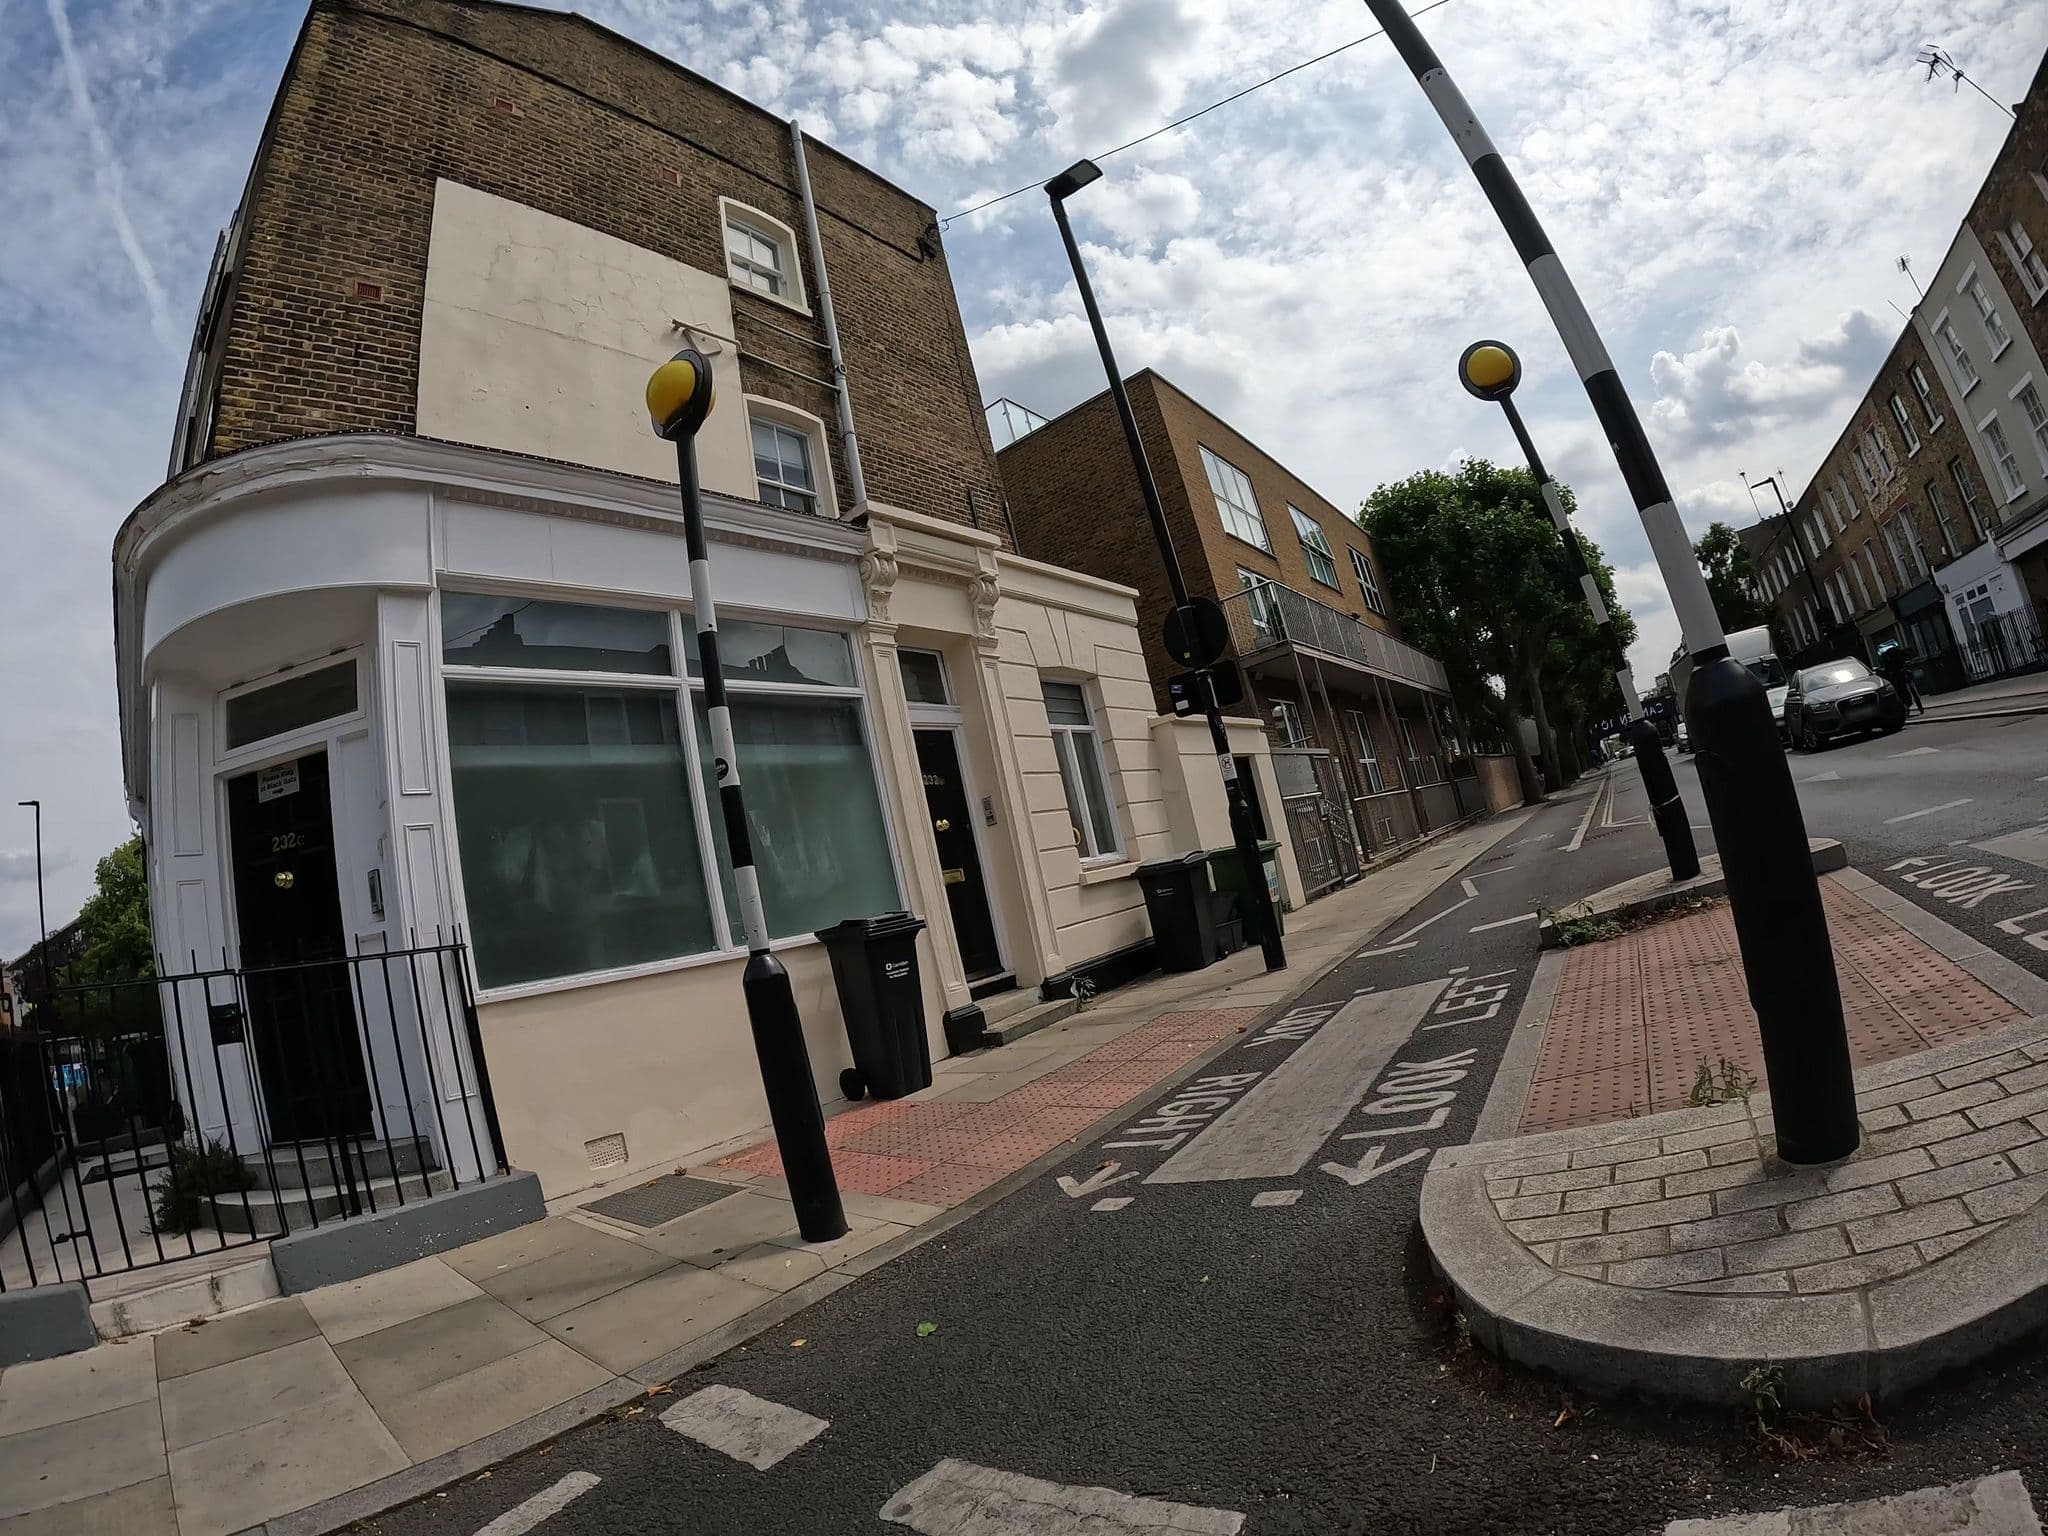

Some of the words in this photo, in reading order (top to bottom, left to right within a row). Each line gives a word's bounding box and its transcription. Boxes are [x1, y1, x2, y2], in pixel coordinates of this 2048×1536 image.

[1900, 859, 2038, 909] LOOK
[1243, 1000, 1346, 1049] LOOK
[1340, 1048, 1479, 1141] LOOK
[1422, 968, 1518, 1031] LEFT
[1102, 1070, 1263, 1152] RIGHT
